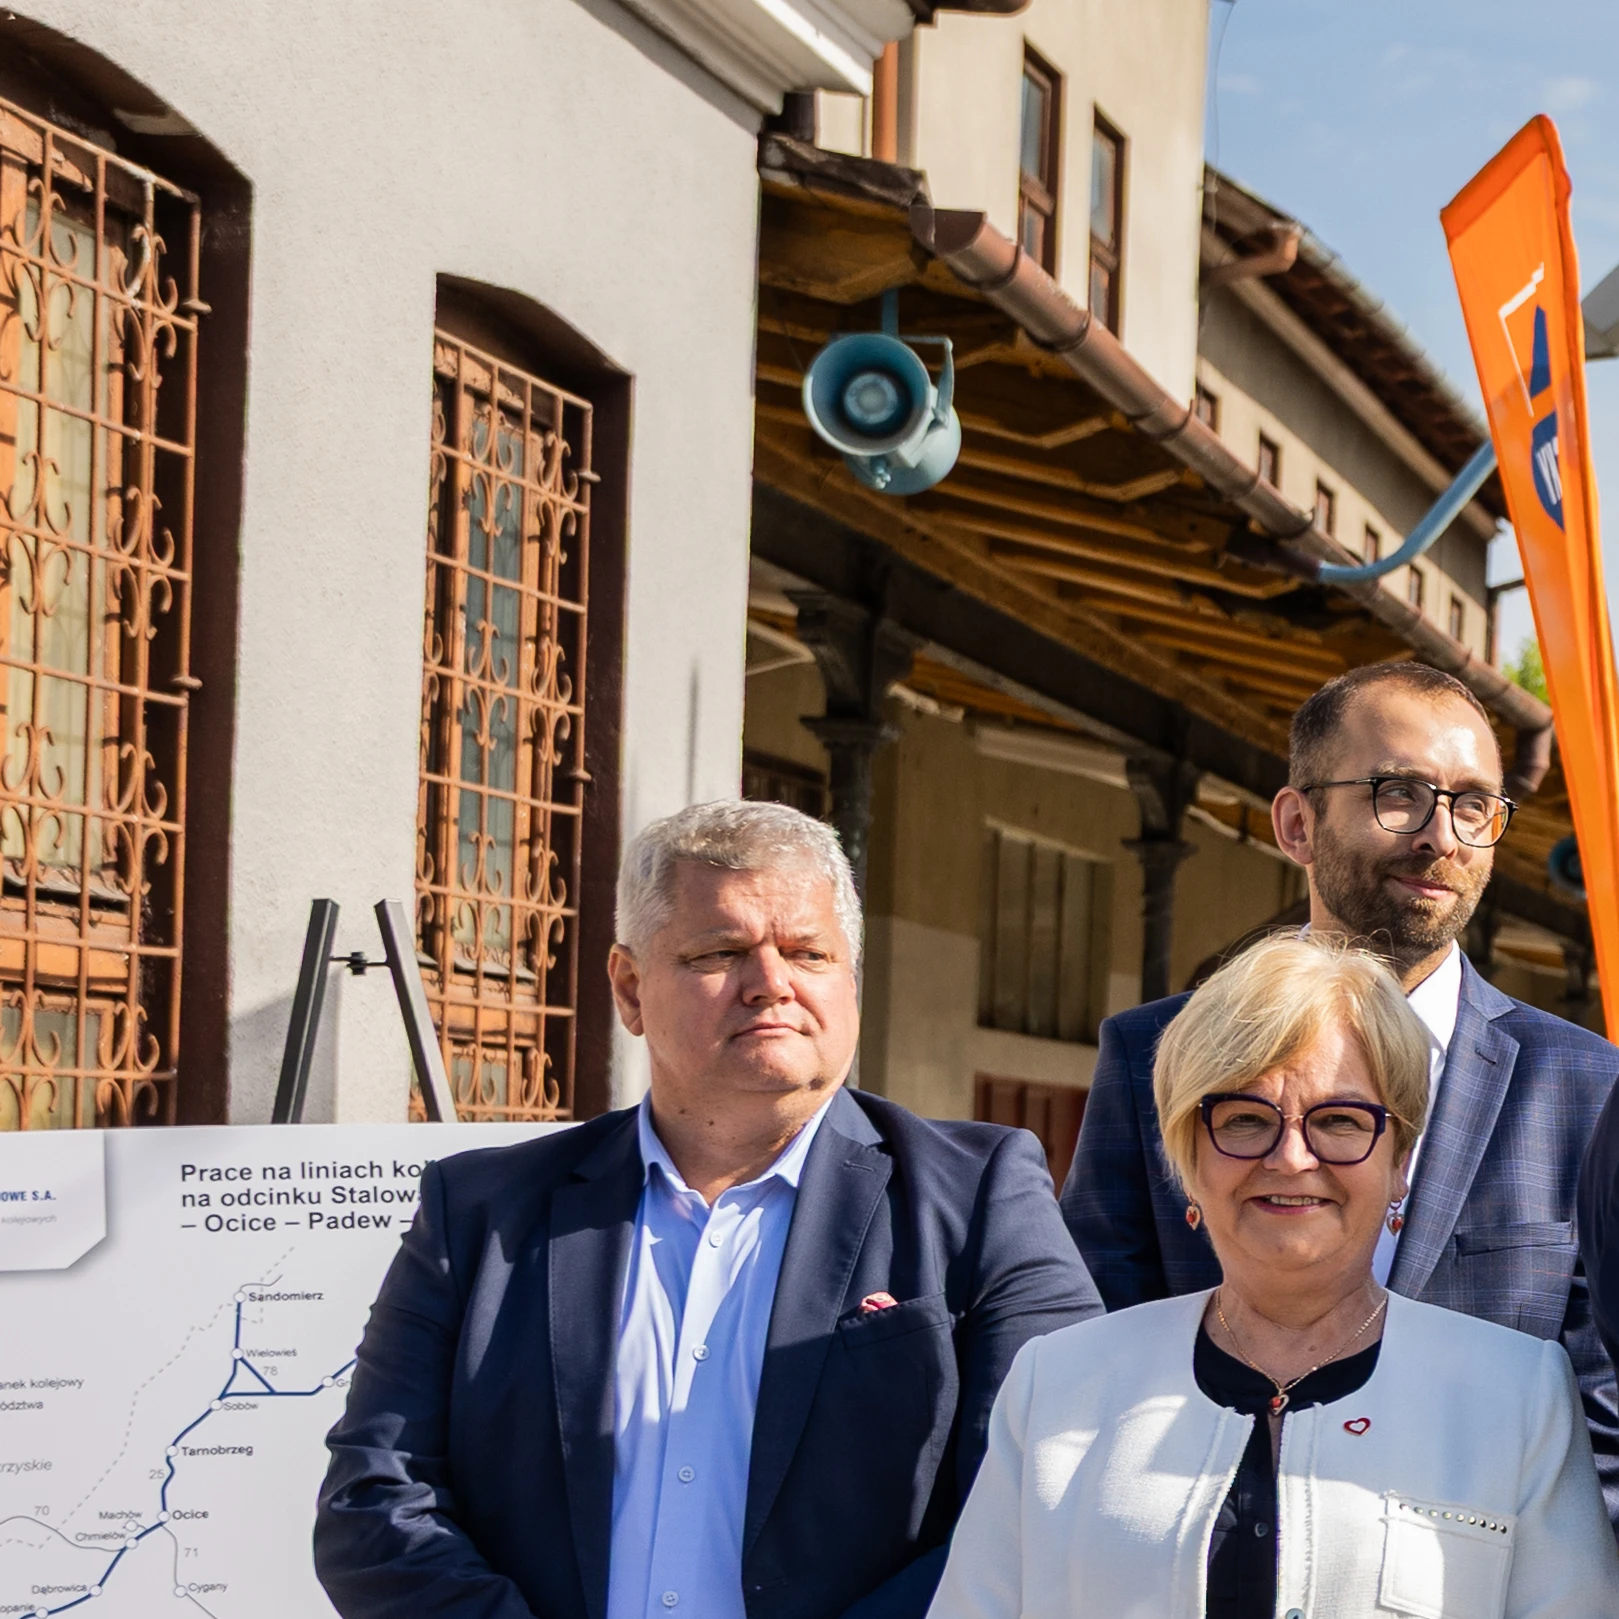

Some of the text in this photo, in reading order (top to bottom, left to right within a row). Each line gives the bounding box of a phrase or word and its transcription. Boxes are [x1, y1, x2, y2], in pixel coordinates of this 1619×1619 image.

[181, 1160, 427, 1182] Prace na liniach ko
[32, 1190, 57, 1201] S.A.
[181, 1186, 420, 1208] na odcinku Stalow
[205, 1213, 276, 1232] Ocice
[309, 1211, 392, 1230] Padew
[249, 1291, 324, 1302] Sandomierz
[246, 1348, 297, 1358] Wielowieś
[263, 1366, 278, 1376] 78
[30, 1377, 84, 1390] kolejowy
[224, 1401, 259, 1411] Sobów
[181, 1446, 254, 1457] Tarnobrzeg
[149, 1469, 165, 1480] 25
[34, 1505, 50, 1516] 70
[99, 1510, 143, 1520] Machów
[172, 1509, 209, 1520] Ocice
[75, 1531, 127, 1542] Chmielów
[185, 1548, 199, 1558] 71
[31, 1583, 88, 1596] Dąbrowica
[188, 1582, 228, 1593] Cygany
